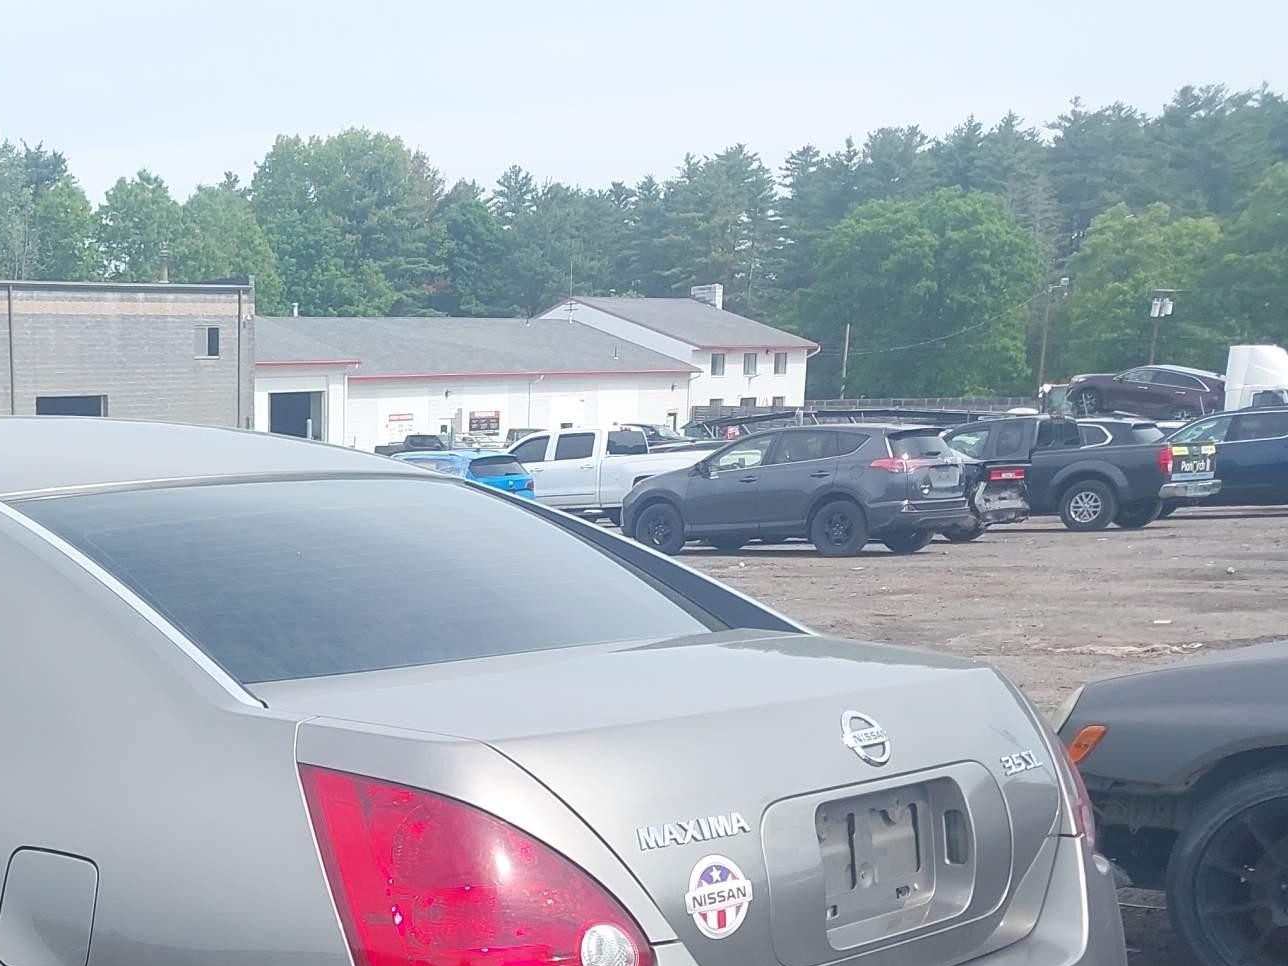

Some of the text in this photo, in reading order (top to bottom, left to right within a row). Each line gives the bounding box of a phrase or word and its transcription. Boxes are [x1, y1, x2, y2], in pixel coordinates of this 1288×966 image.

[852, 728, 888, 745] NISSAN
[636, 811, 752, 851] MAXIMA
[692, 885, 747, 909] NISSAN
